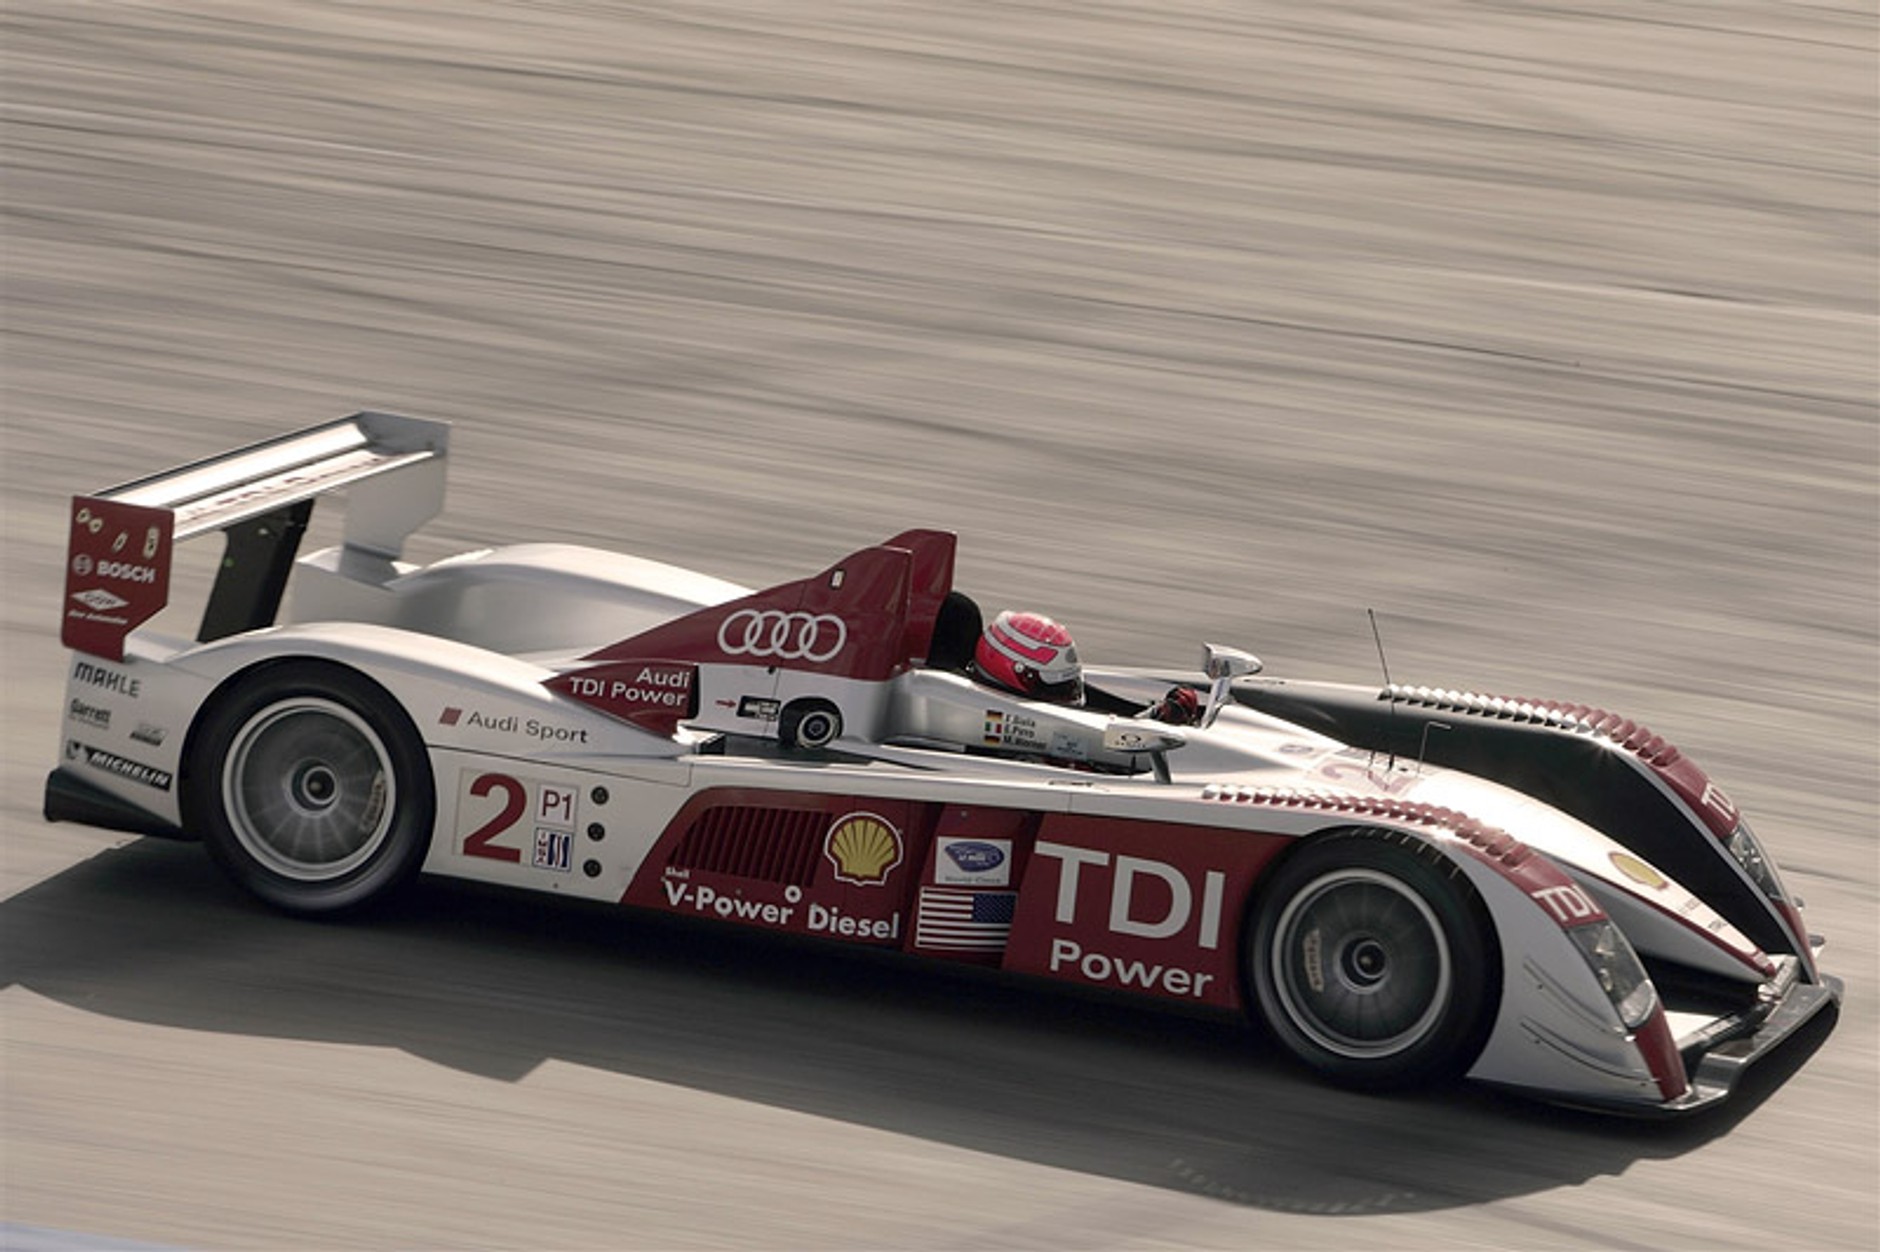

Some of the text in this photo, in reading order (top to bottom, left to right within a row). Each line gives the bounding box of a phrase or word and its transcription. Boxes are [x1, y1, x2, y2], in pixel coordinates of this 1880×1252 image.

[97, 560, 156, 584] BOSCH
[75, 662, 141, 699] MAHLE
[570, 676, 687, 706] TDI Power
[635, 667, 691, 689] Audi
[467, 711, 588, 744] Audi Sport
[91, 751, 170, 786] MICHELIN
[463, 773, 527, 863] 2
[542, 790, 572, 820] P1
[664, 880, 899, 938] V-Power Diesel
[1034, 840, 1226, 949] TDI
[1530, 883, 1602, 921] TDI
[1050, 938, 1214, 997] Power
